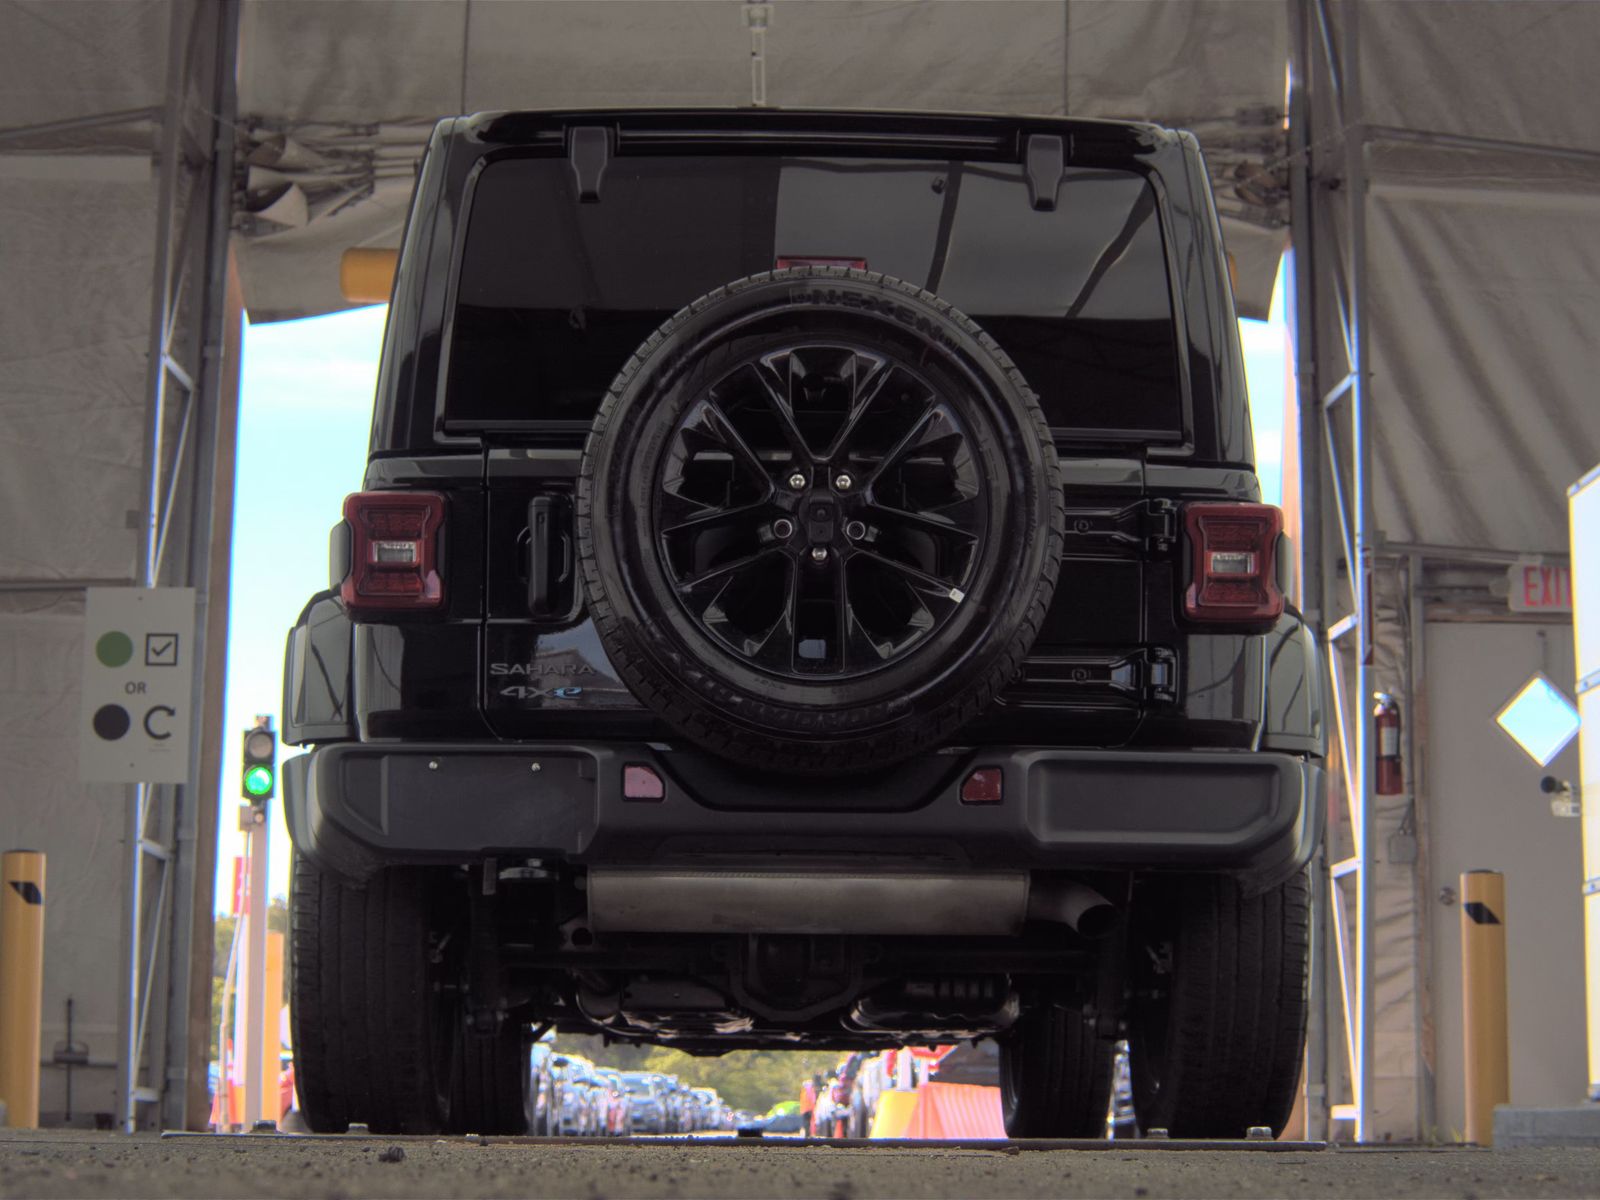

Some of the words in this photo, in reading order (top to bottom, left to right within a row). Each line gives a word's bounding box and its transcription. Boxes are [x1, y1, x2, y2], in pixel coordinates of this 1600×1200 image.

[812, 289, 946, 343] NEXEN
[1524, 566, 1572, 607] EXIT
[490, 663, 594, 675] SAHARA
[125, 681, 146, 695] OR
